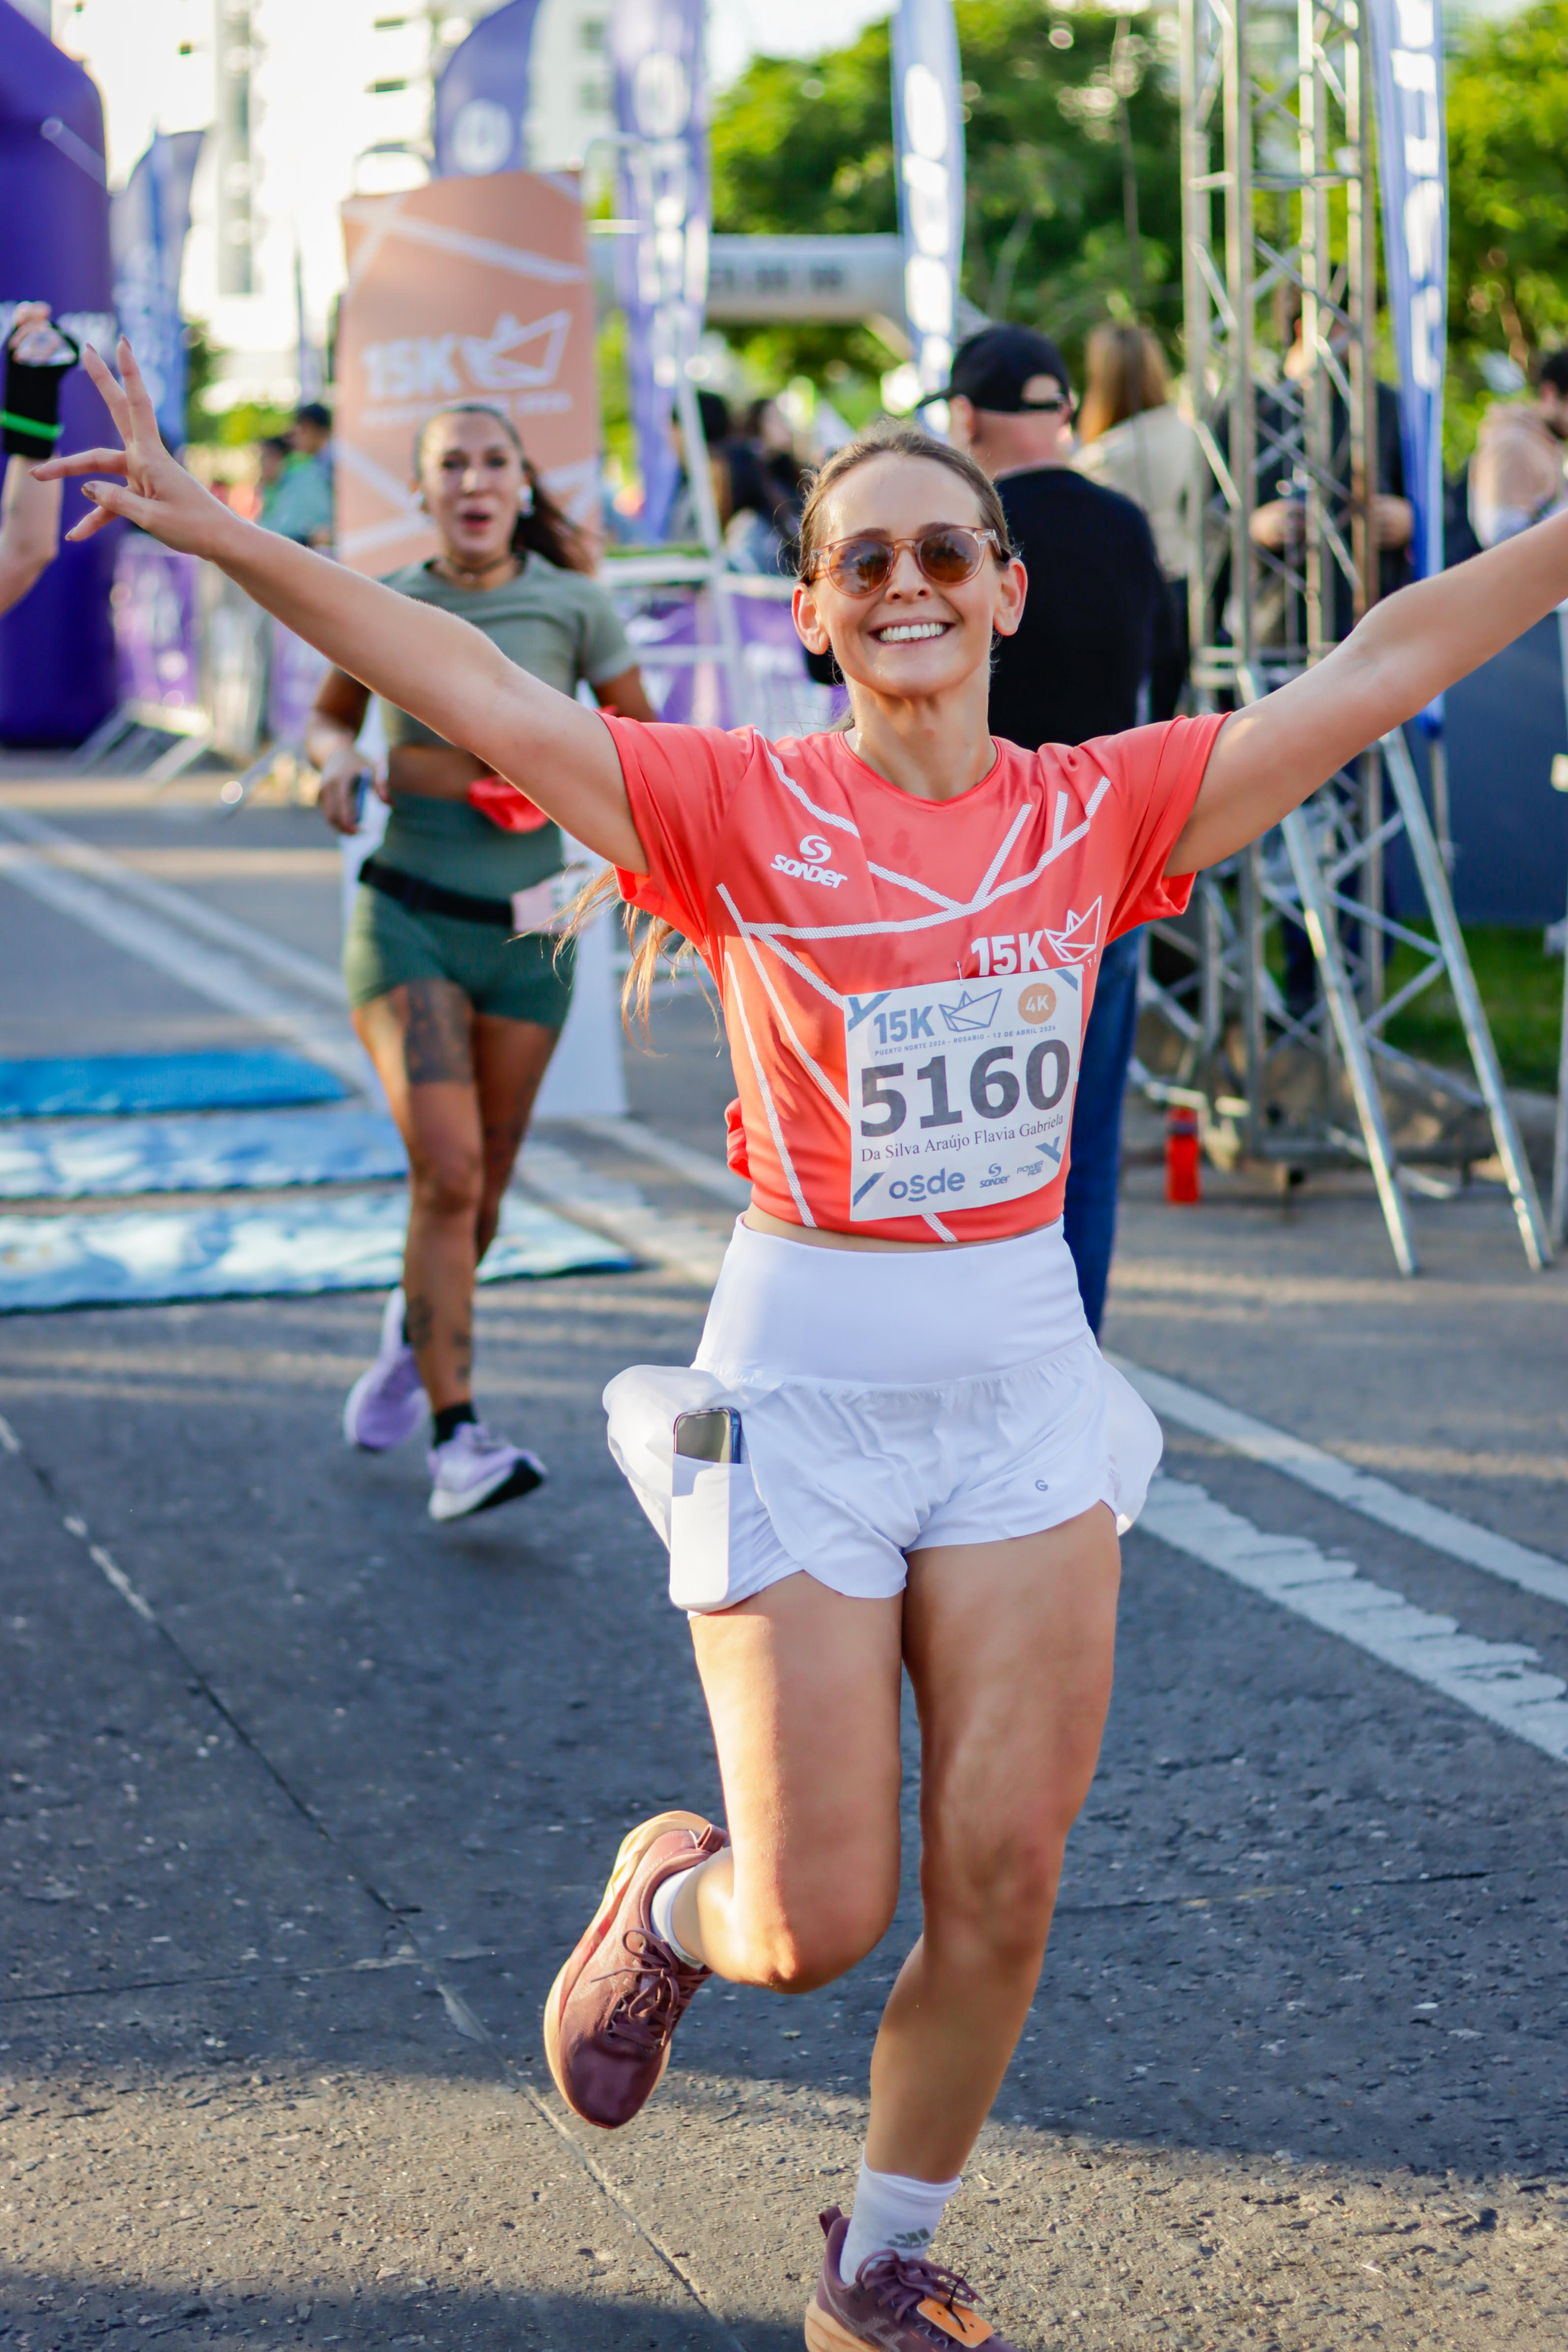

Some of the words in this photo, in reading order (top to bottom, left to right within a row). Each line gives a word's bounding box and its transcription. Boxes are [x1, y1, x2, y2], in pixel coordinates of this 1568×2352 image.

[361, 332, 461, 400] 15K
[971, 930, 1049, 976] 15K
[1025, 994, 1050, 1012] 4K
[874, 1005, 935, 1044] 15K
[875, 1046, 902, 1057] PUERTO
[904, 1042, 927, 1052] NORTE
[929, 1040, 946, 1048] 2026
[953, 1034, 984, 1044] ROSARIO
[1016, 1028, 1037, 1036] ABRIL
[1039, 1025, 1056, 1033] 2026
[860, 1039, 1071, 1137] 5160
[861, 1148, 881, 1162] Da
[886, 1143, 920, 1159] Silva
[924, 1134, 970, 1152] Araújo
[974, 1126, 1015, 1145] Flavia
[1019, 1114, 1064, 1137] Gabriela
[888, 1167, 966, 1200] osde
